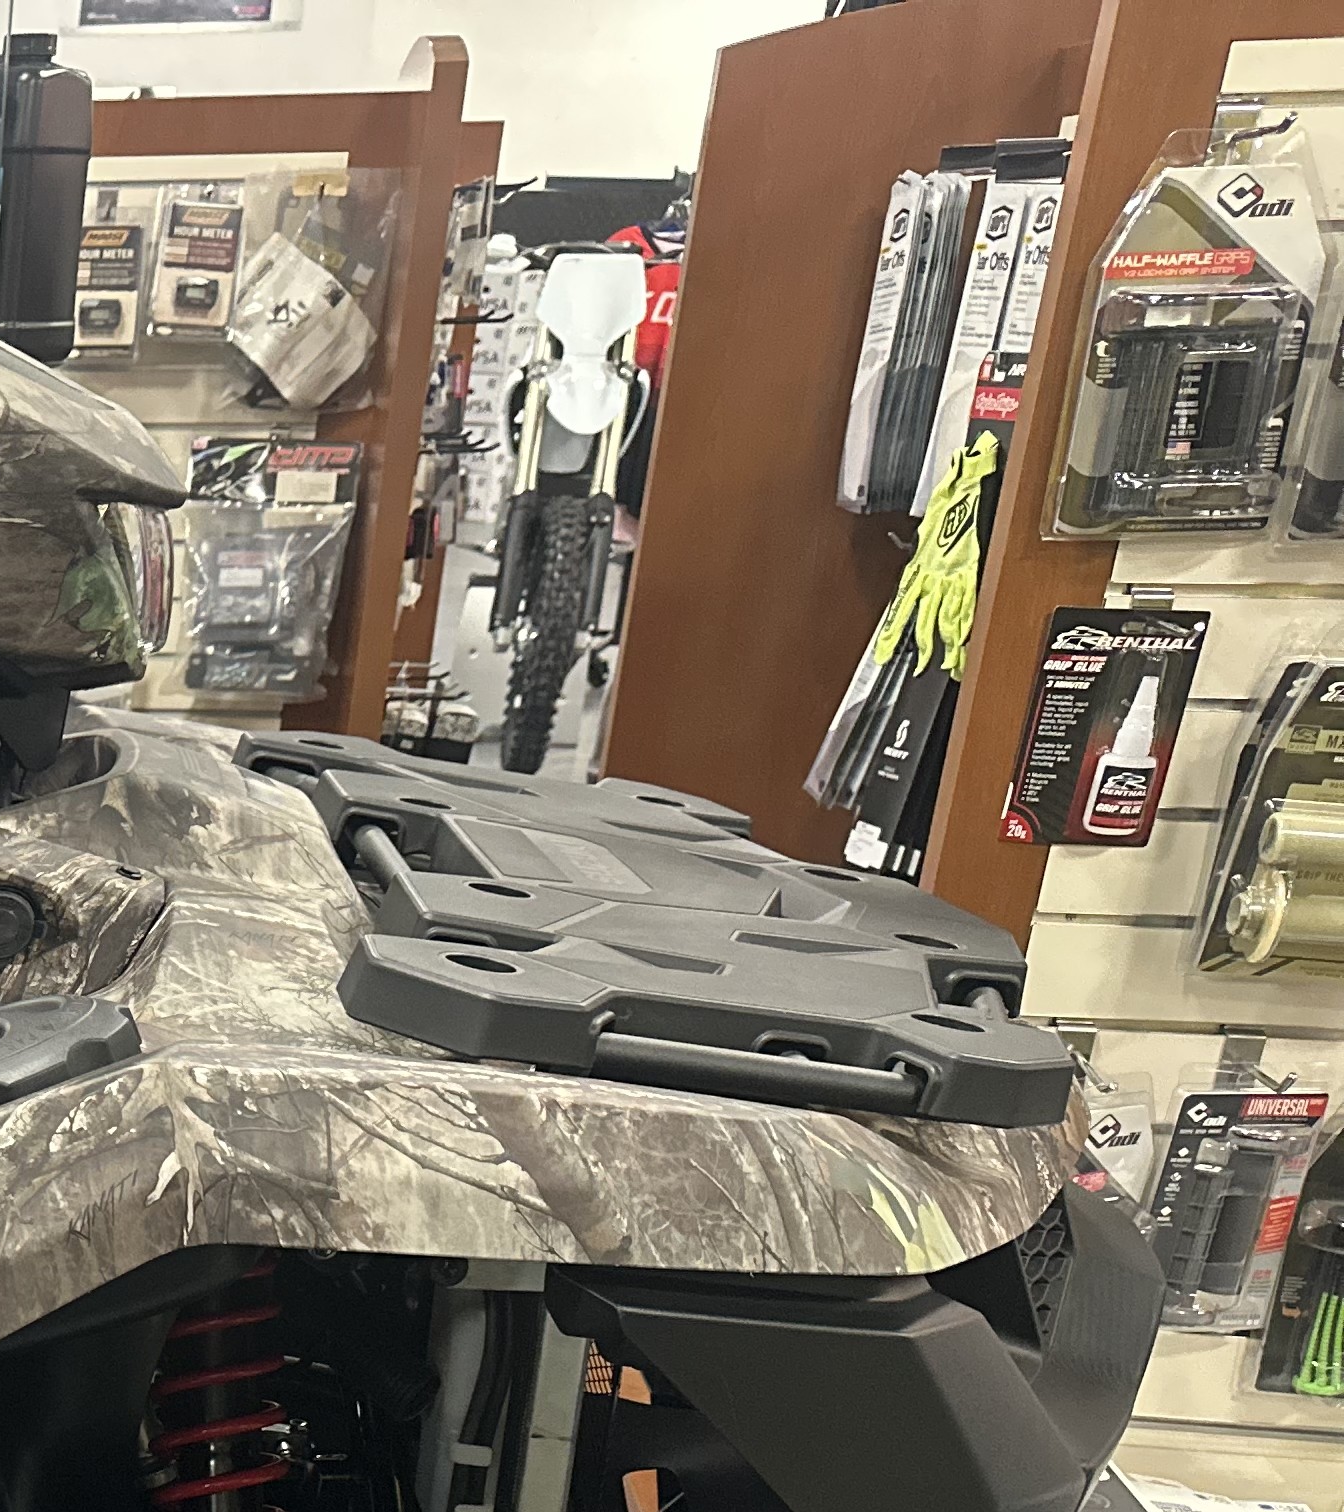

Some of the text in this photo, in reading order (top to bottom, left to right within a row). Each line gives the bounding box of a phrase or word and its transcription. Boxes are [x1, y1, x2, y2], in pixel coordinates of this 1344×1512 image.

[201, 228, 234, 239] METER
[79, 249, 135, 259] OUR METER
[1112, 250, 1251, 268] HALF-WAFFLE GRIPS
[1095, 635, 1198, 650] RENTHAL
[1043, 660, 1106, 673] GRIP GLUE
[1099, 788, 1147, 797] RENTHAL
[1006, 824, 1027, 839] 20g
[1247, 1098, 1310, 1116] UNIVERSAL
